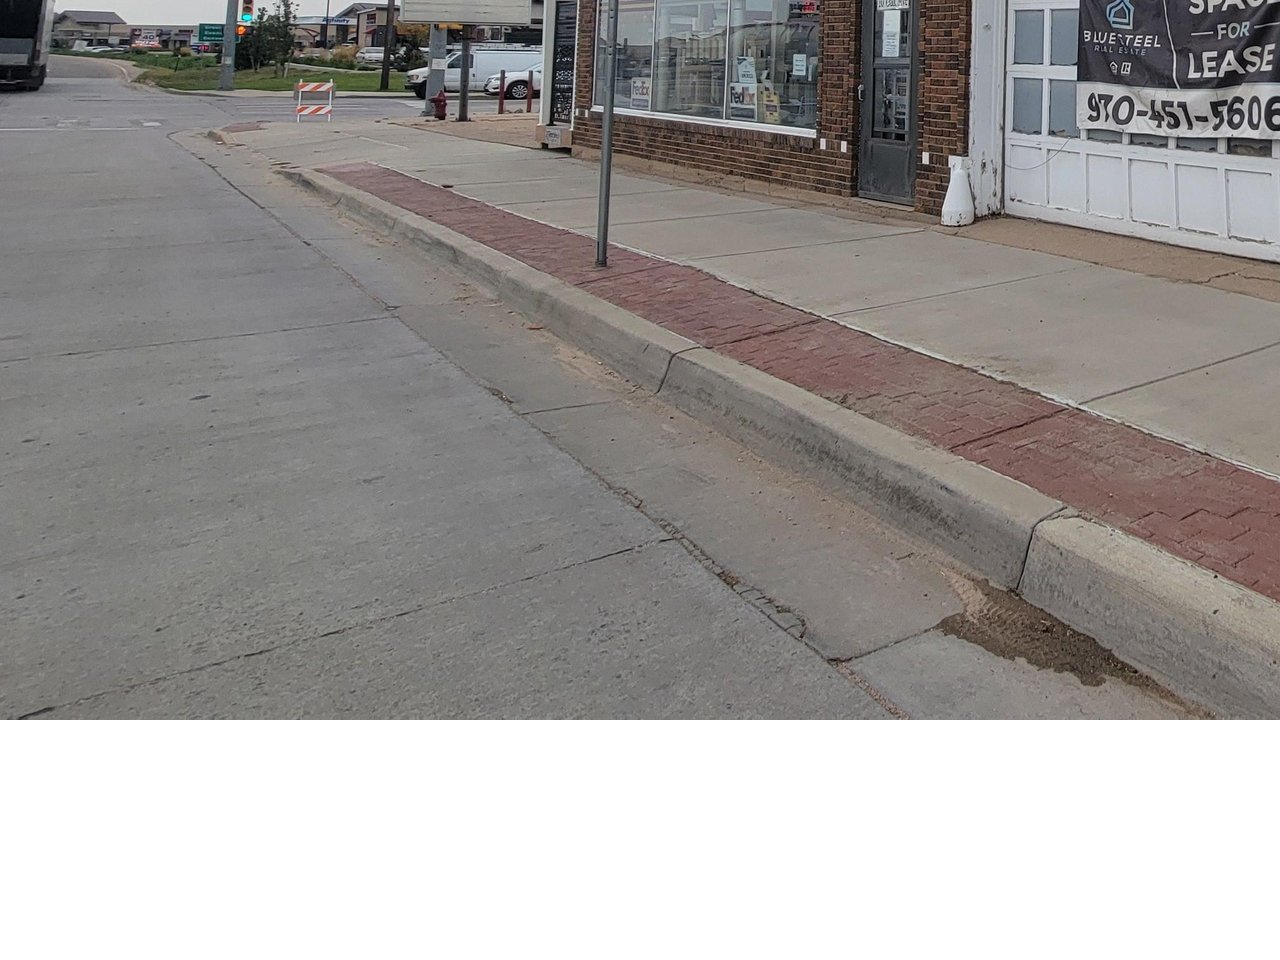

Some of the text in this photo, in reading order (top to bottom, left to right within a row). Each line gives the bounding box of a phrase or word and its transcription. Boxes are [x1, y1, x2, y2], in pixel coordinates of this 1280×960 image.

[1217, 21, 1250, 40] FOR
[1118, 46, 1147, 56] ESTE
[1187, 43, 1276, 79] LEASE
